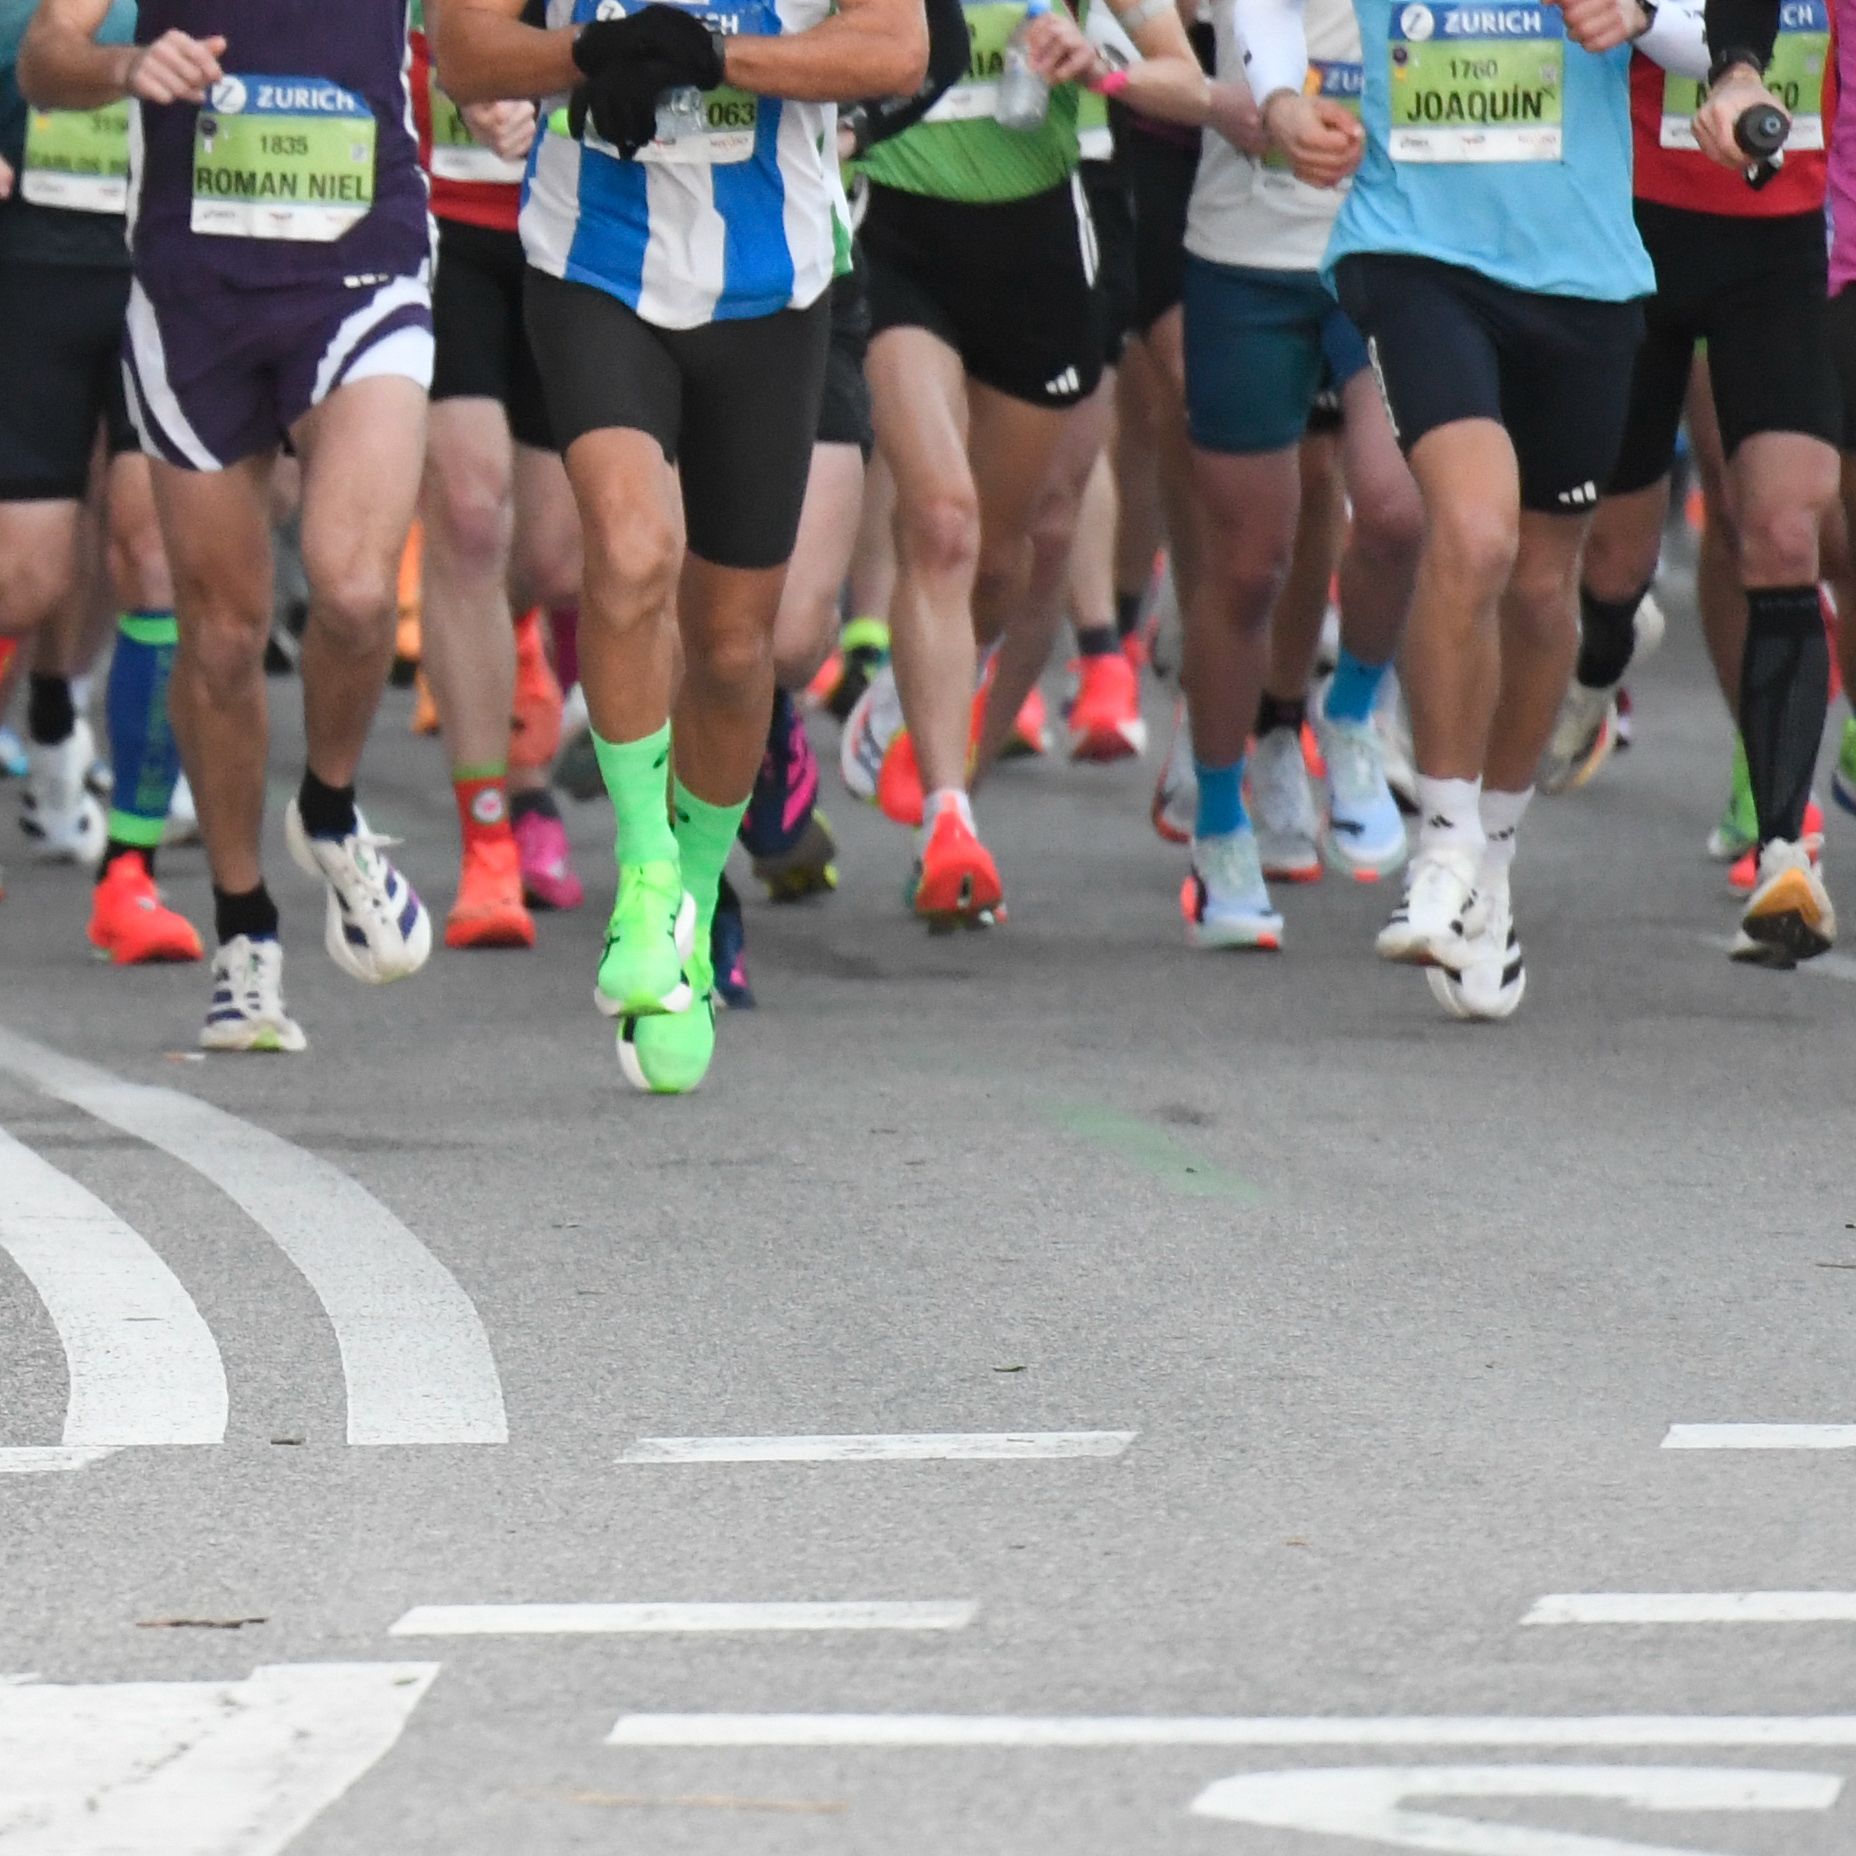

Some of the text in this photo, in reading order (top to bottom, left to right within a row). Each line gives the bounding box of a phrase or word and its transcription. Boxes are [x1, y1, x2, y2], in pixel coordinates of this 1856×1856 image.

[1444, 10, 1542, 33] ZURICH
[256, 84, 356, 111] ZURICH
[1407, 84, 1542, 122] JOAQUÍN
[708, 102, 755, 127] 063
[196, 167, 370, 202] ROMAN NIEL
